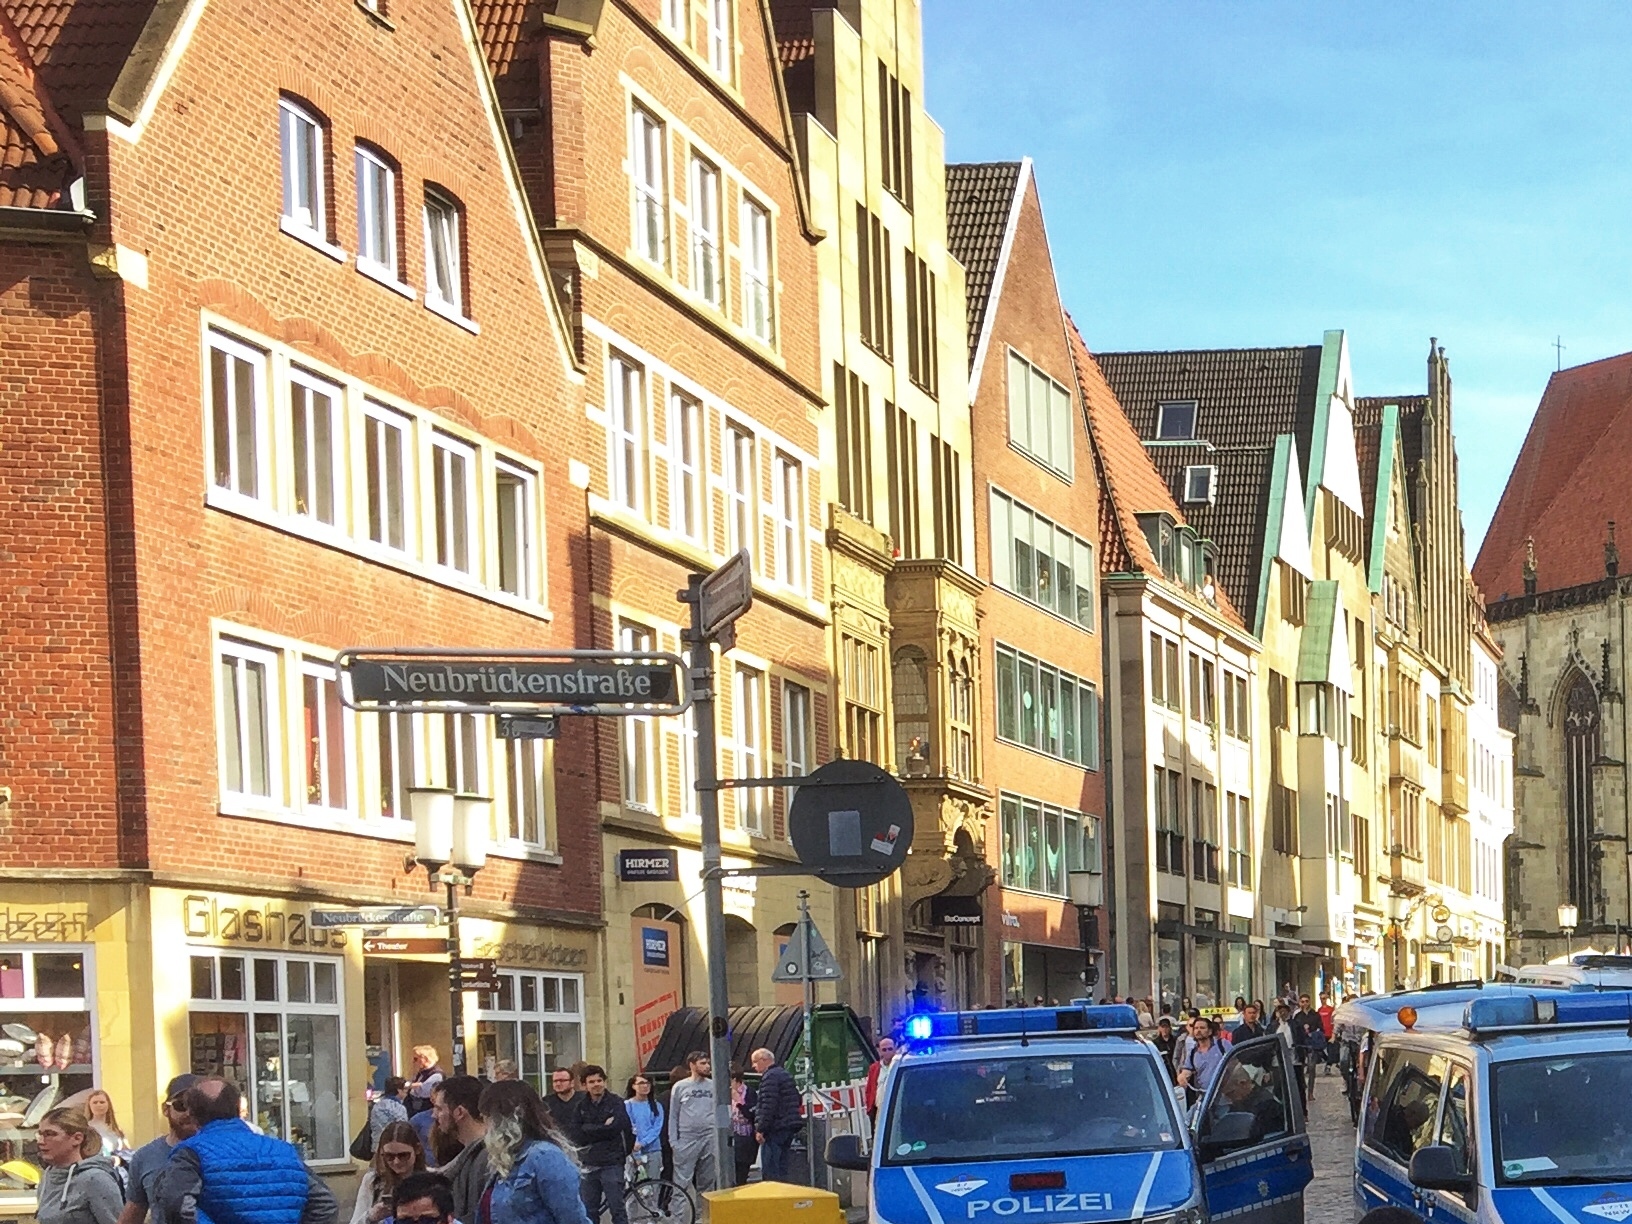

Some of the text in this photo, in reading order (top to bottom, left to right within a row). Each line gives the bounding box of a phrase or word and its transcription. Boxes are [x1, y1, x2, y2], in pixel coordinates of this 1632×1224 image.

[381, 664, 651, 697] Neubrückenstraße
[625, 858, 670, 869] HIRMER
[377, 942, 408, 951] Theater
[967, 1192, 1113, 1219] POLIZEI
